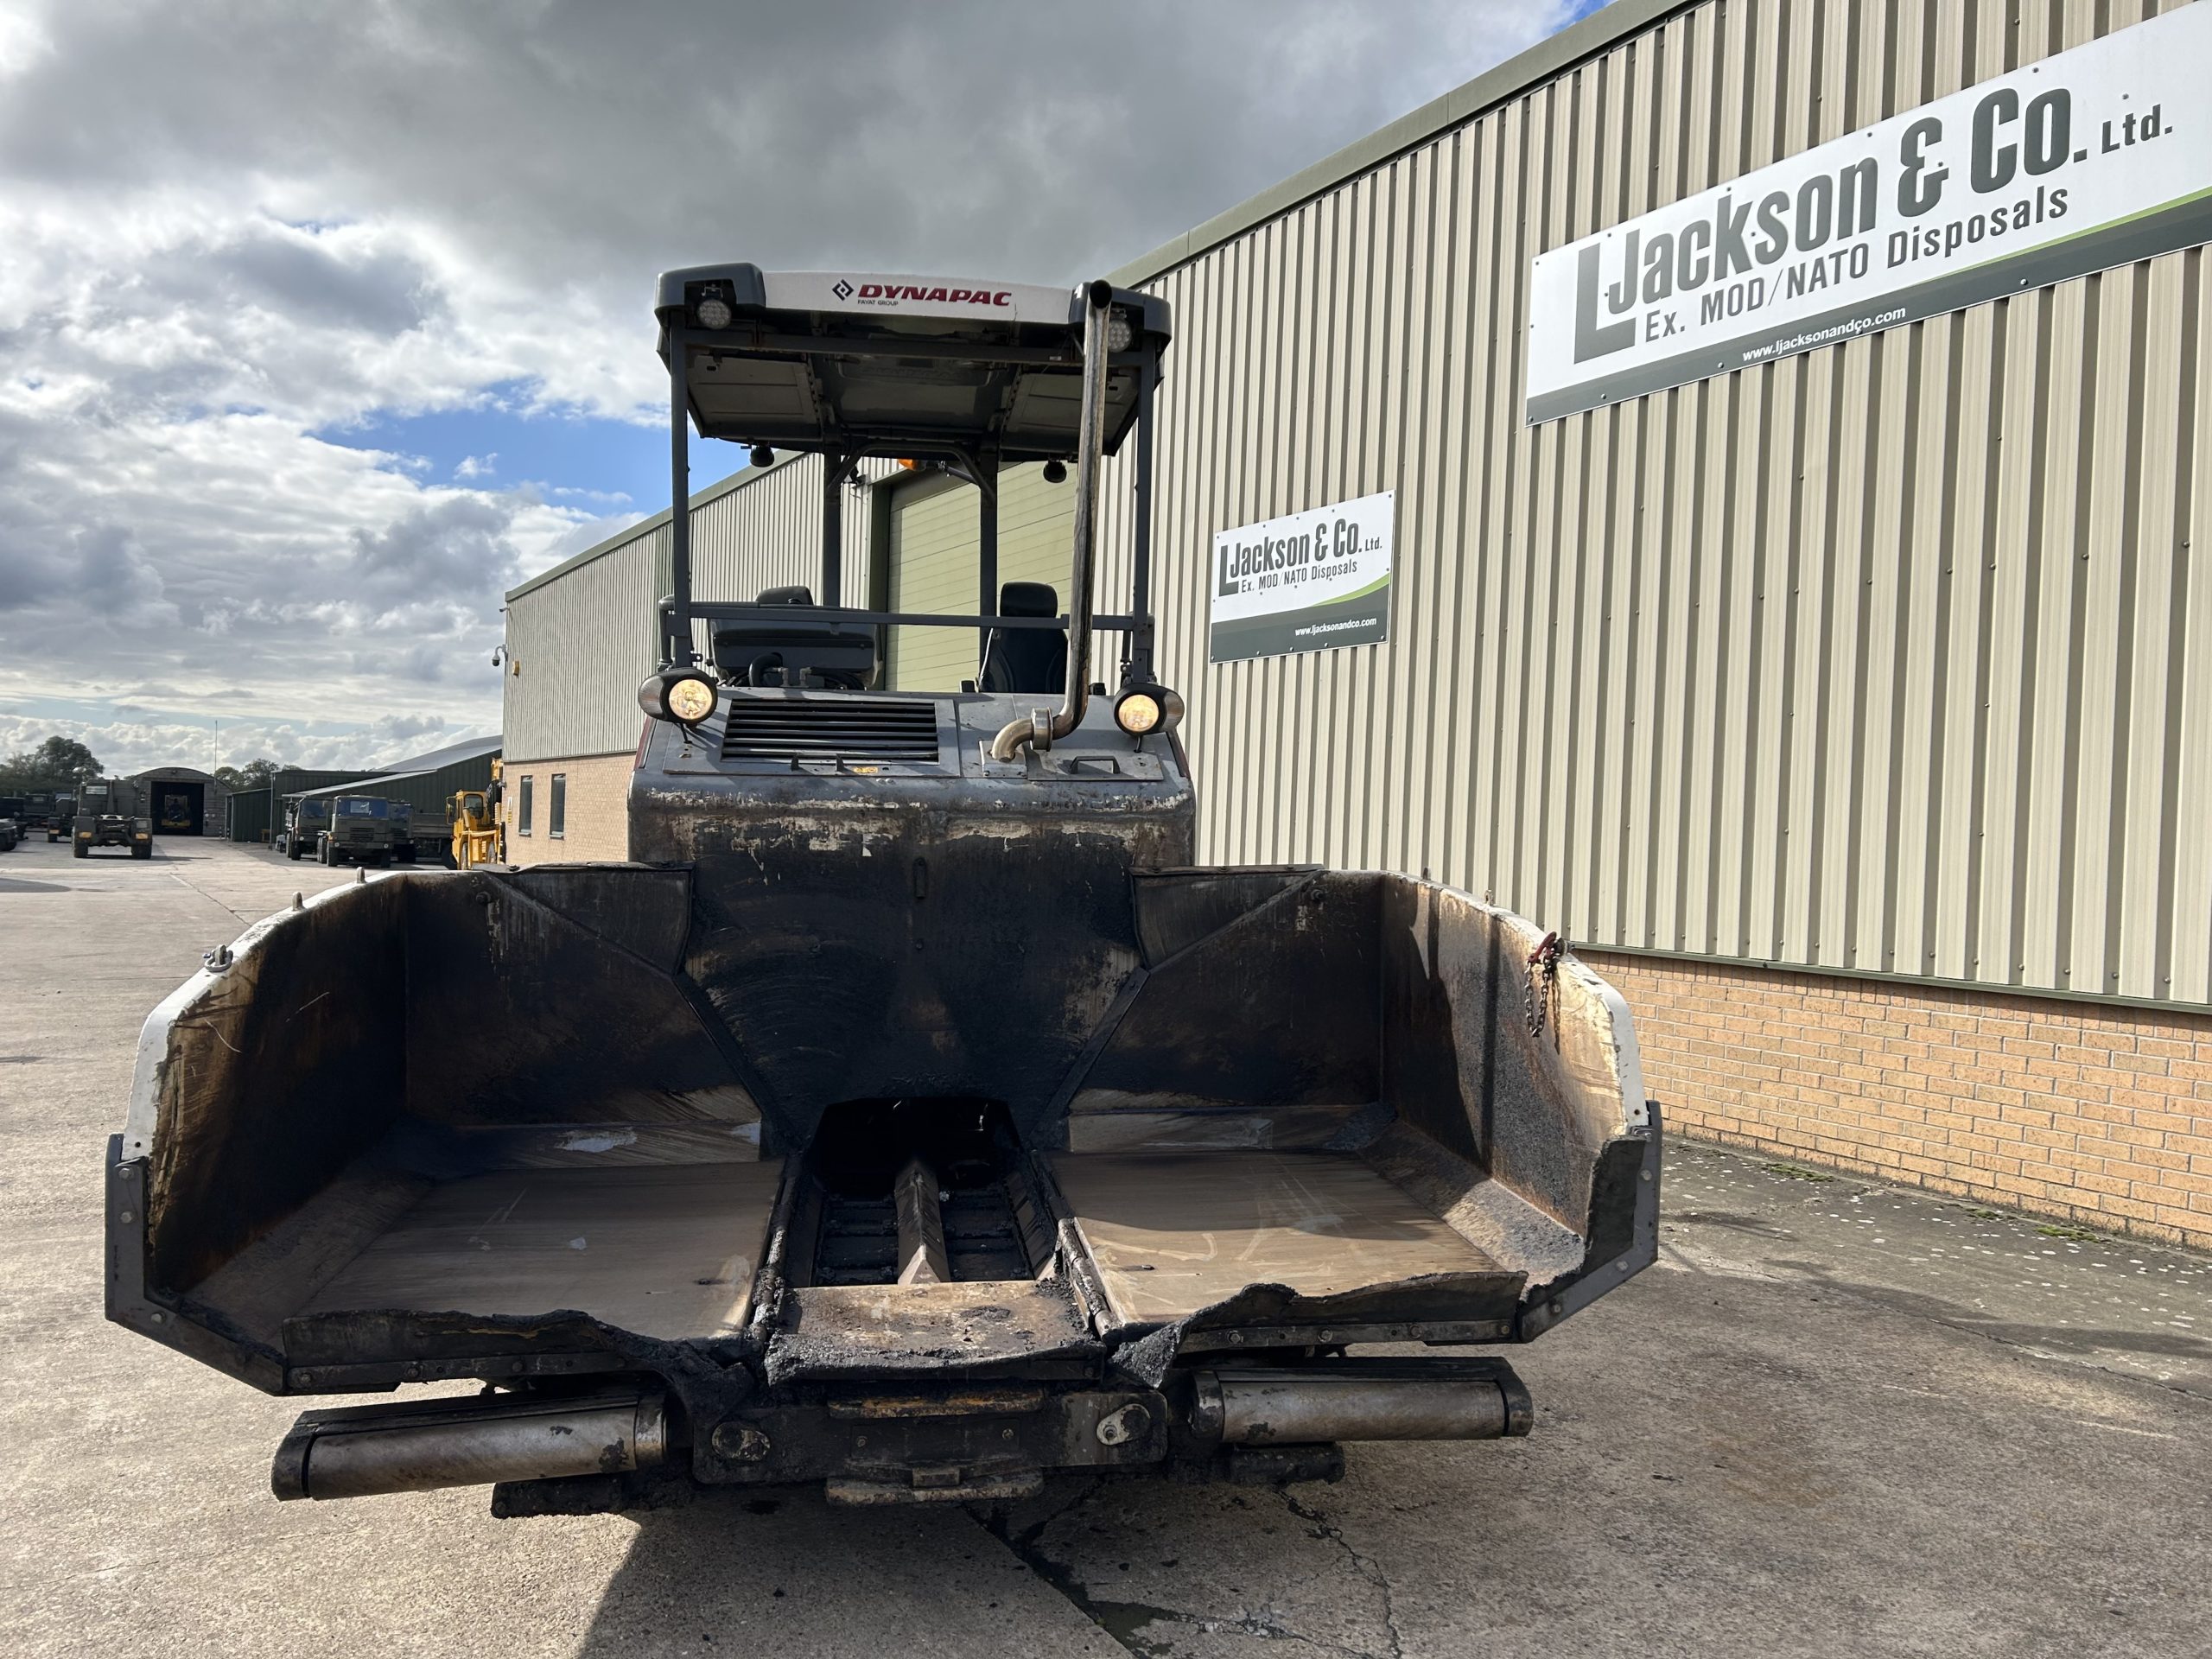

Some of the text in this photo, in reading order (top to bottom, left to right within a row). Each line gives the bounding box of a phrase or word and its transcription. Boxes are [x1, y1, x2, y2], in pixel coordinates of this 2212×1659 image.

[1897, 116, 1949, 218] &
[1970, 87, 2088, 194] Co.
[2101, 105, 2173, 154] Ltd.
[1645, 185, 2069, 343] Ex. MOD/NATO Disposals
[857, 284, 1012, 306] DYNAPAC
[1742, 307, 1906, 361] www.ljacksonandco.com
[1314, 523, 1329, 562] &
[1333, 518, 1363, 557] Co.
[1364, 537, 1382, 551] Ltd.
[1241, 580, 1255, 593] Ex.
[1311, 558, 1357, 580] Disposals
[1295, 617, 1377, 636] www.ljacksonandco.com
